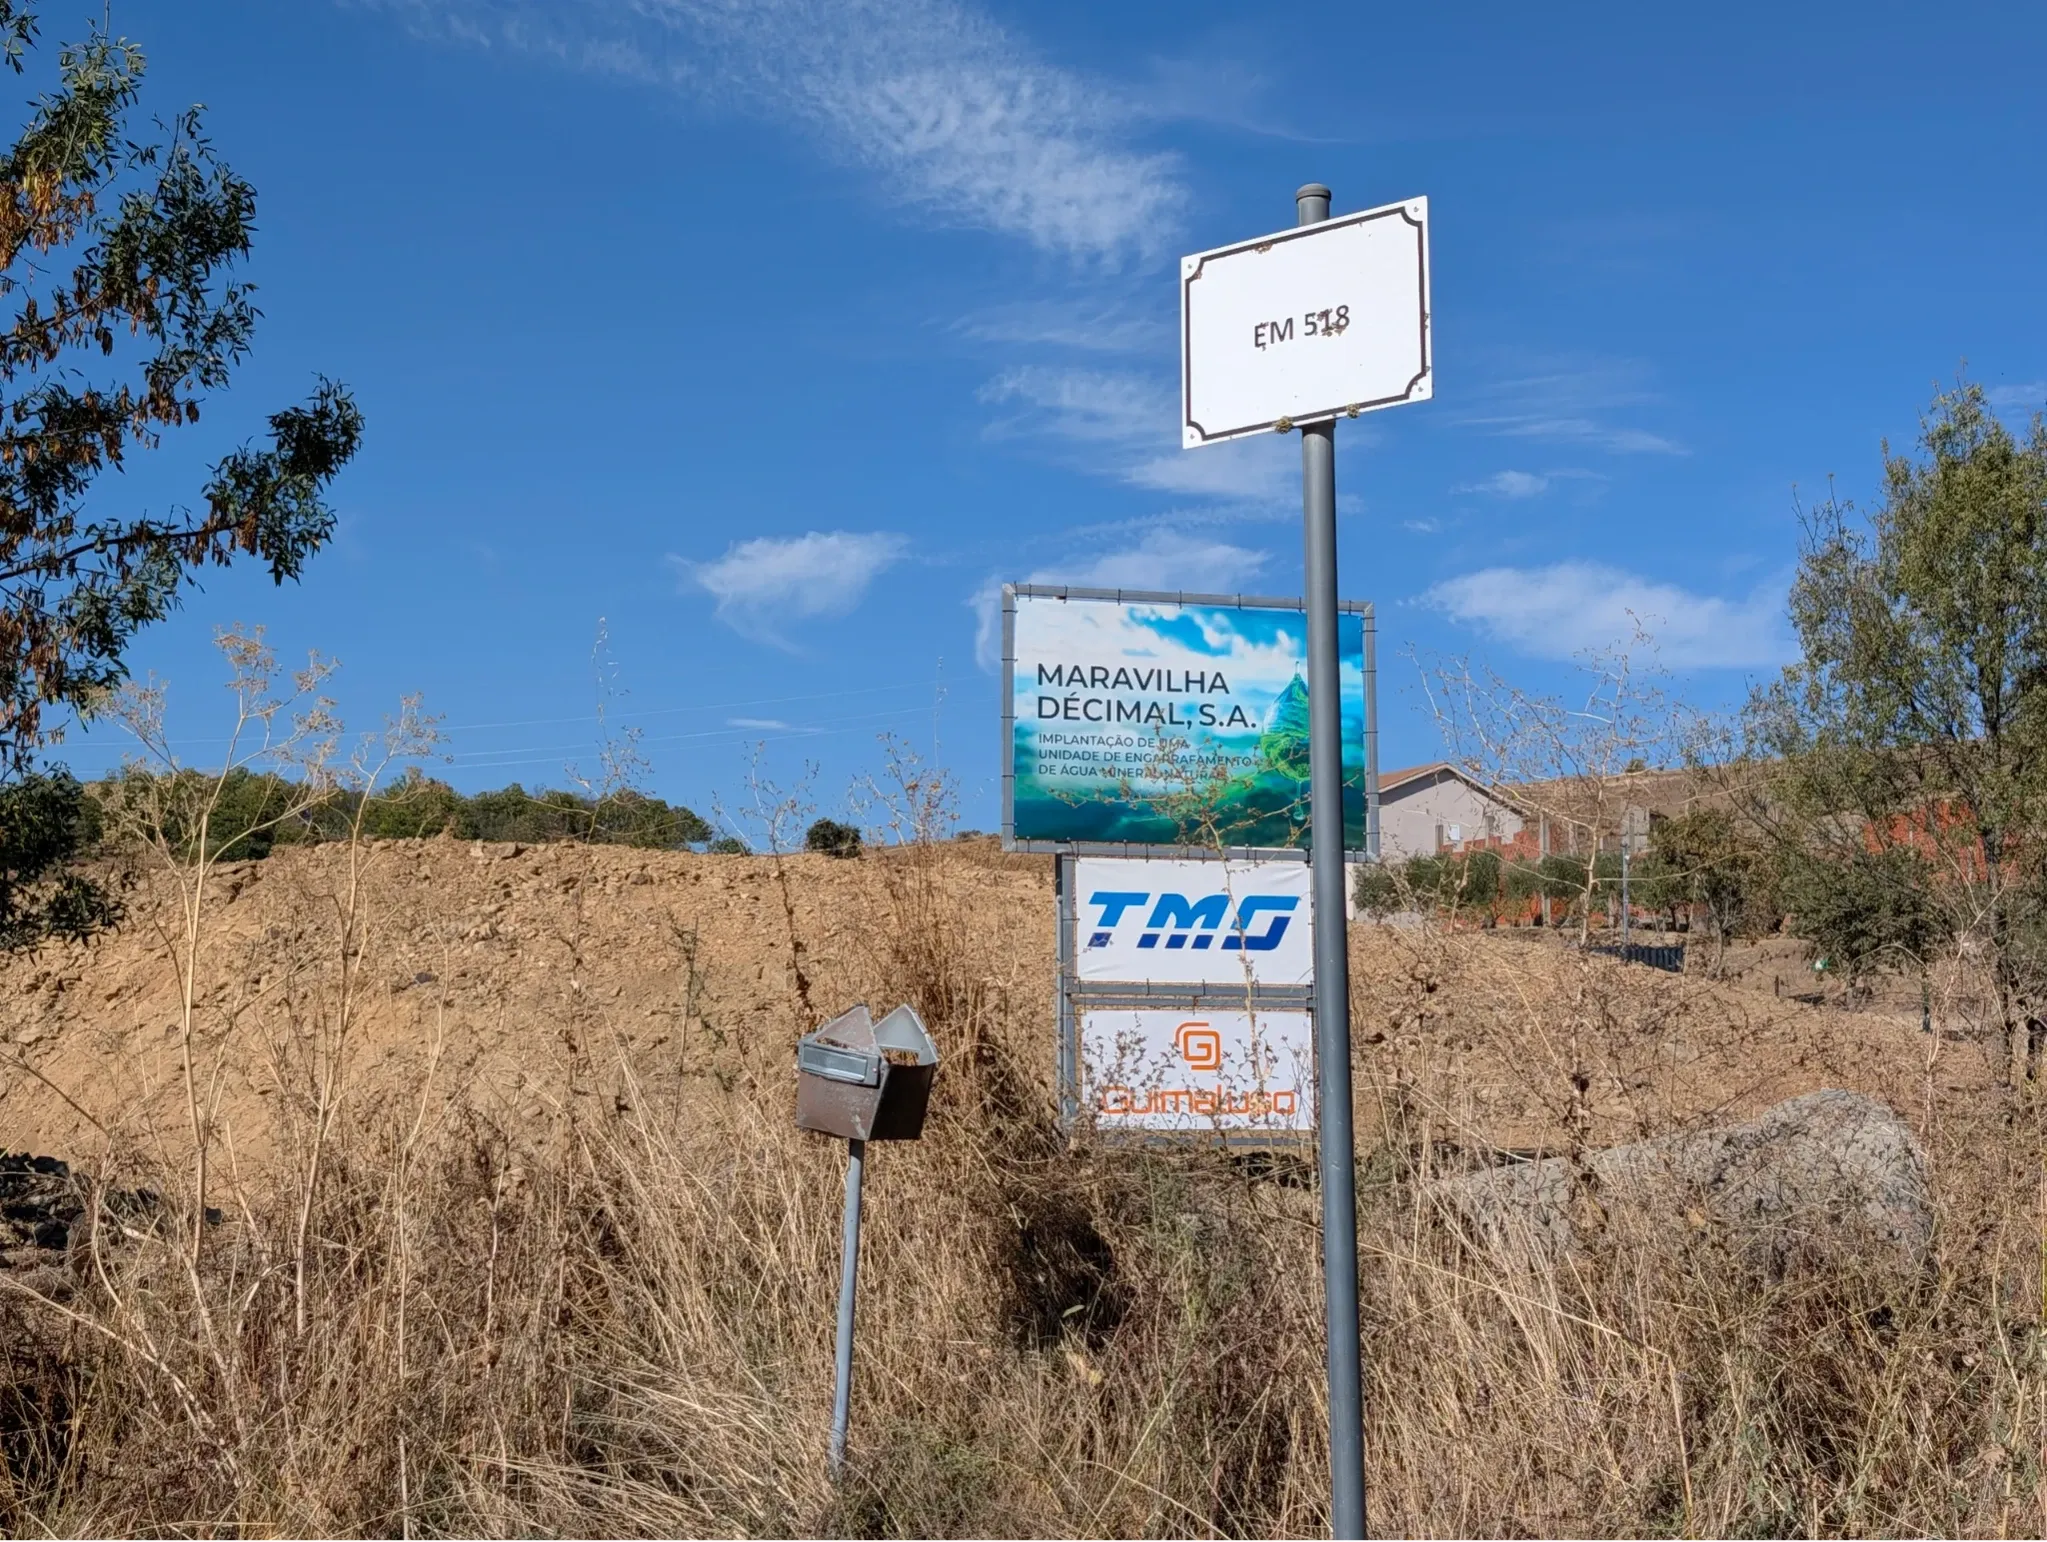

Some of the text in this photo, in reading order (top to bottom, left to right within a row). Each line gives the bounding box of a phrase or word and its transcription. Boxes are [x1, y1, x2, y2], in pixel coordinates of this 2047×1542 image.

[1254, 304, 1350, 348] EM 518
[1037, 662, 1230, 695] MARAVILHA
[1037, 691, 1258, 731] DÉCIMAL, S.A.
[1038, 733, 1134, 749] IMPLANTAÇÃO
[1137, 737, 1156, 748] DE
[1038, 749, 1100, 761] UNIDADE
[1103, 751, 1122, 762] DE
[1038, 764, 1057, 775] DE
[1060, 763, 1098, 777] ÁGUA
